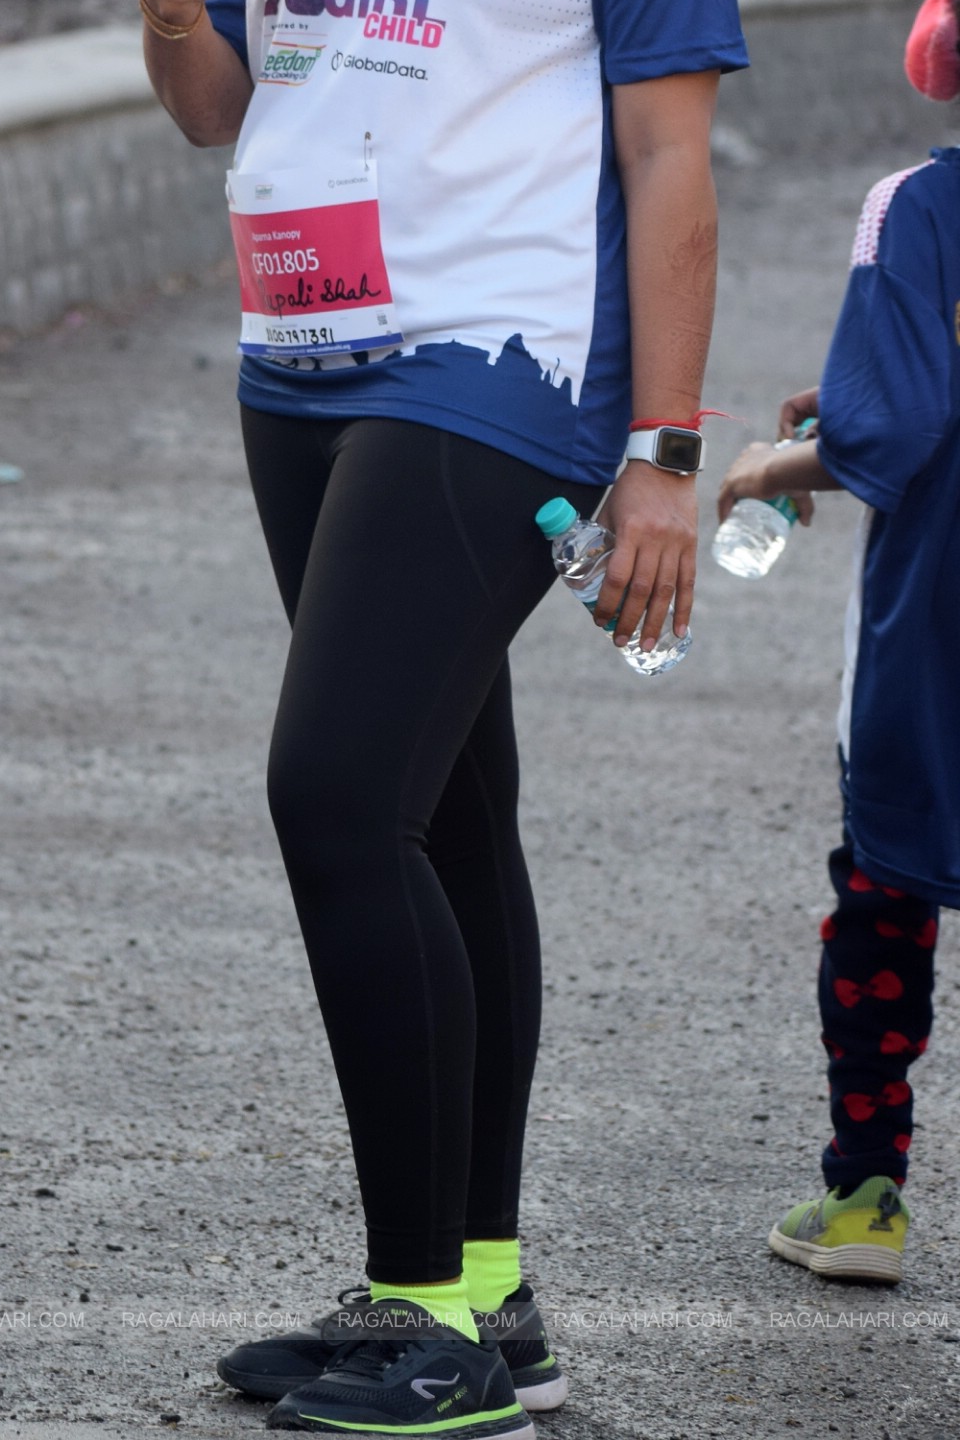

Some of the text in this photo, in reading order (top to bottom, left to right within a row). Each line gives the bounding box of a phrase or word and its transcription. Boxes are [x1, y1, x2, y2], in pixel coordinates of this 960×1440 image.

[363, 13, 444, 49] CHILD
[264, 49, 318, 73] eedom
[252, 247, 320, 276] CF01805
[320, 273, 382, 303] Shah
